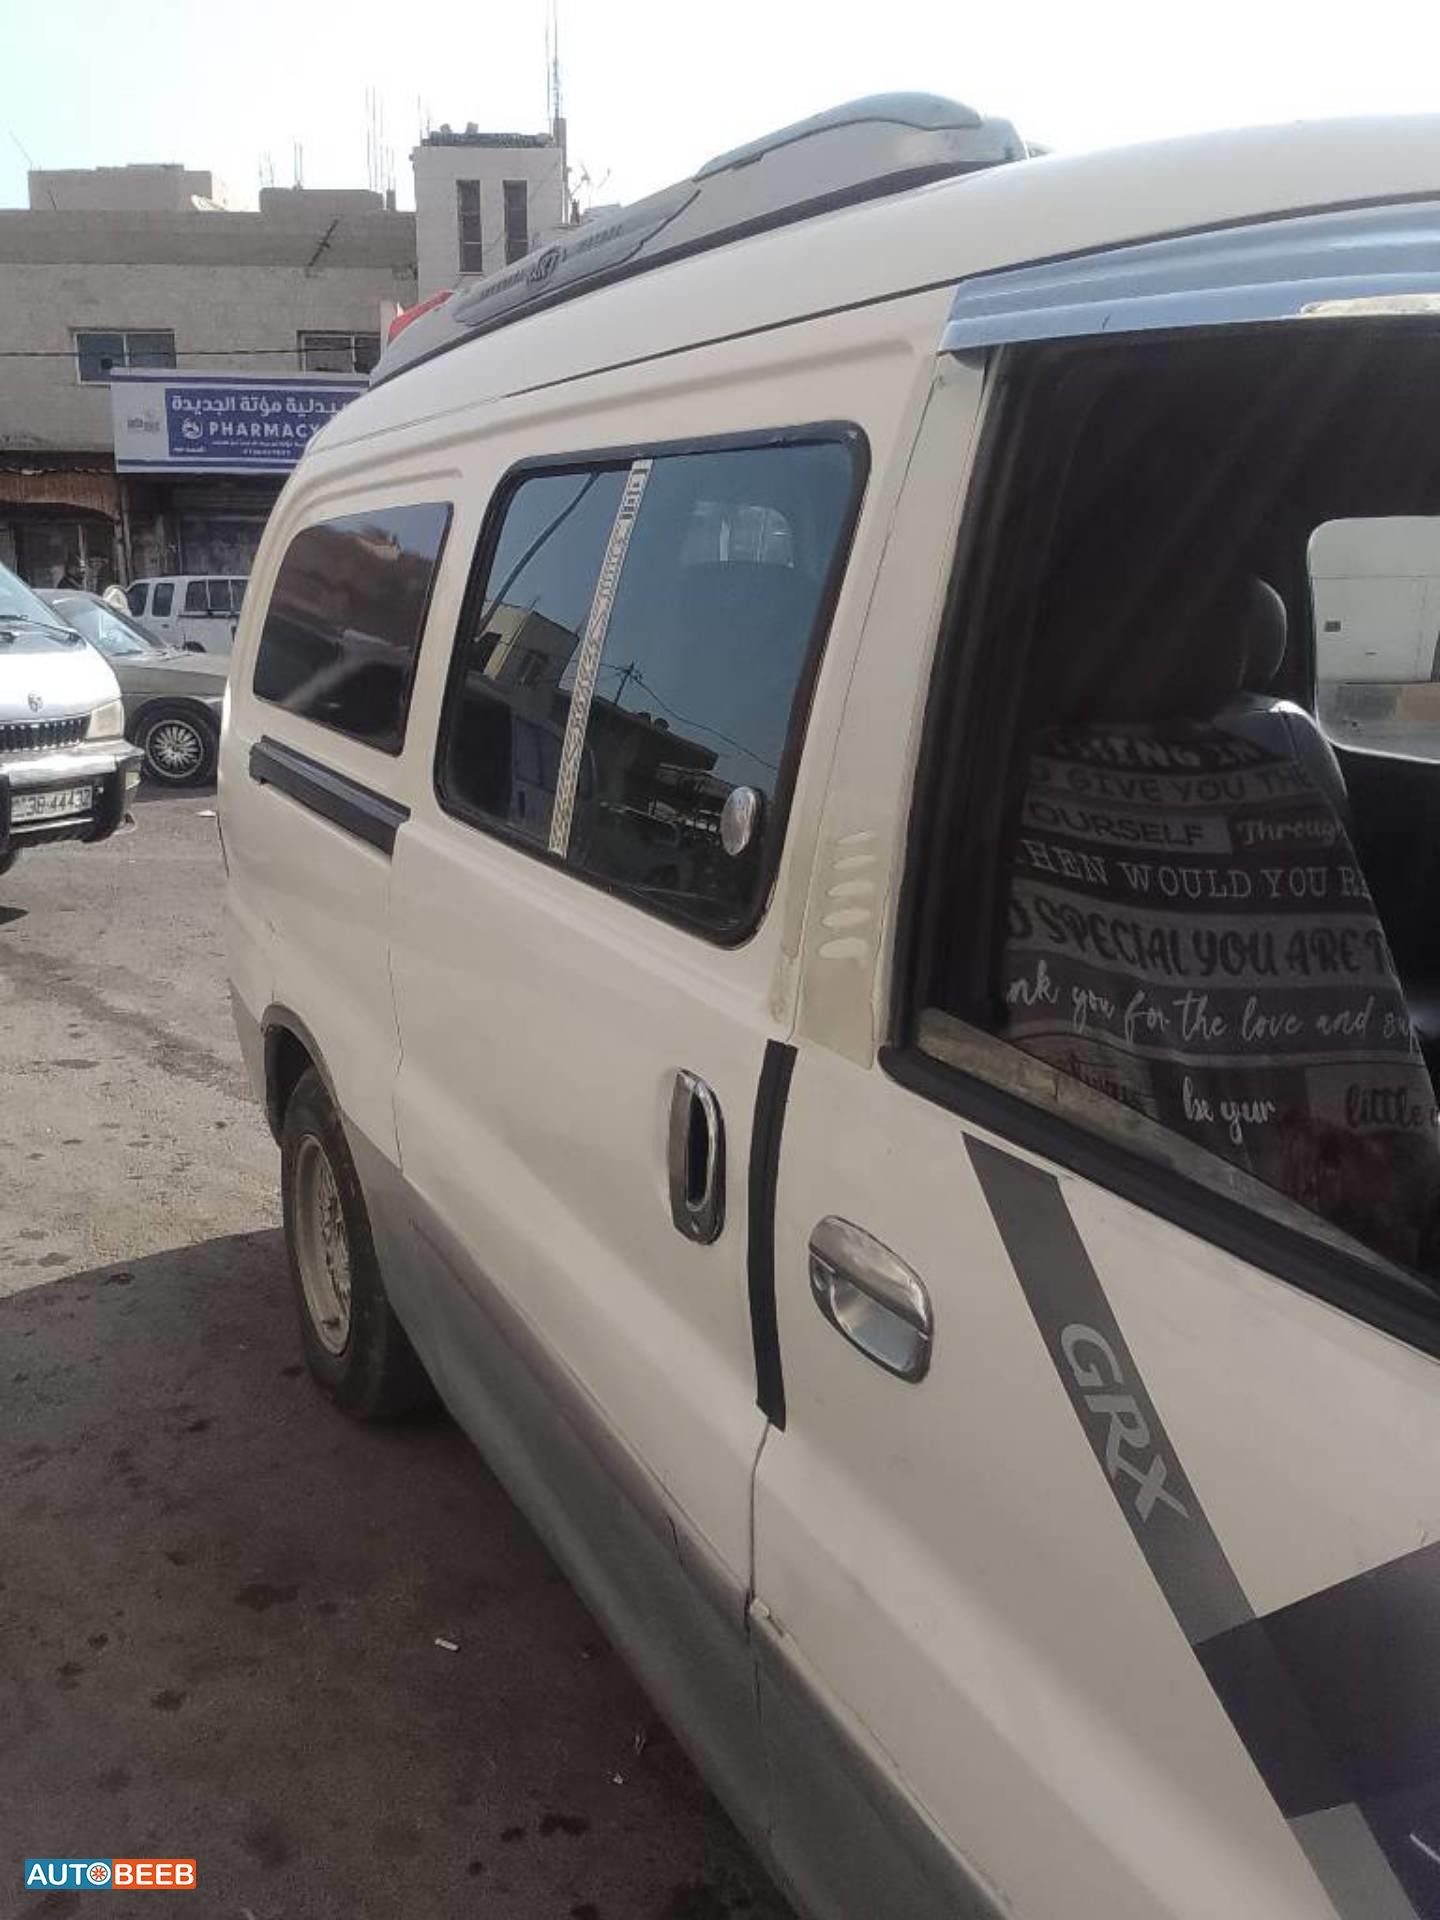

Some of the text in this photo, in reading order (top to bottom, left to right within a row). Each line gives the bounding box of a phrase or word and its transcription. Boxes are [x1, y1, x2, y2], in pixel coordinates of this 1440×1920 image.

[171, 396, 235, 416] الجديدة
[209, 420, 320, 439] PHARMACY
[286, 397, 347, 417] يدلية
[1066, 766, 1160, 797] GIVE
[1168, 777, 1246, 803] YOU
[1014, 839, 1110, 887] HEN
[1116, 861, 1252, 899] WOULD
[1260, 865, 1328, 898] YOU
[1034, 895, 1190, 976] SPECIAL
[1191, 929, 1277, 977] YOU
[1285, 928, 1361, 977] ARE
[1071, 986, 1115, 1034] you
[1124, 989, 1170, 1046] for
[1172, 988, 1228, 1041] the
[1241, 995, 1304, 1041] love
[1315, 995, 1376, 1040] and
[1061, 1322, 1191, 1524] GRX
